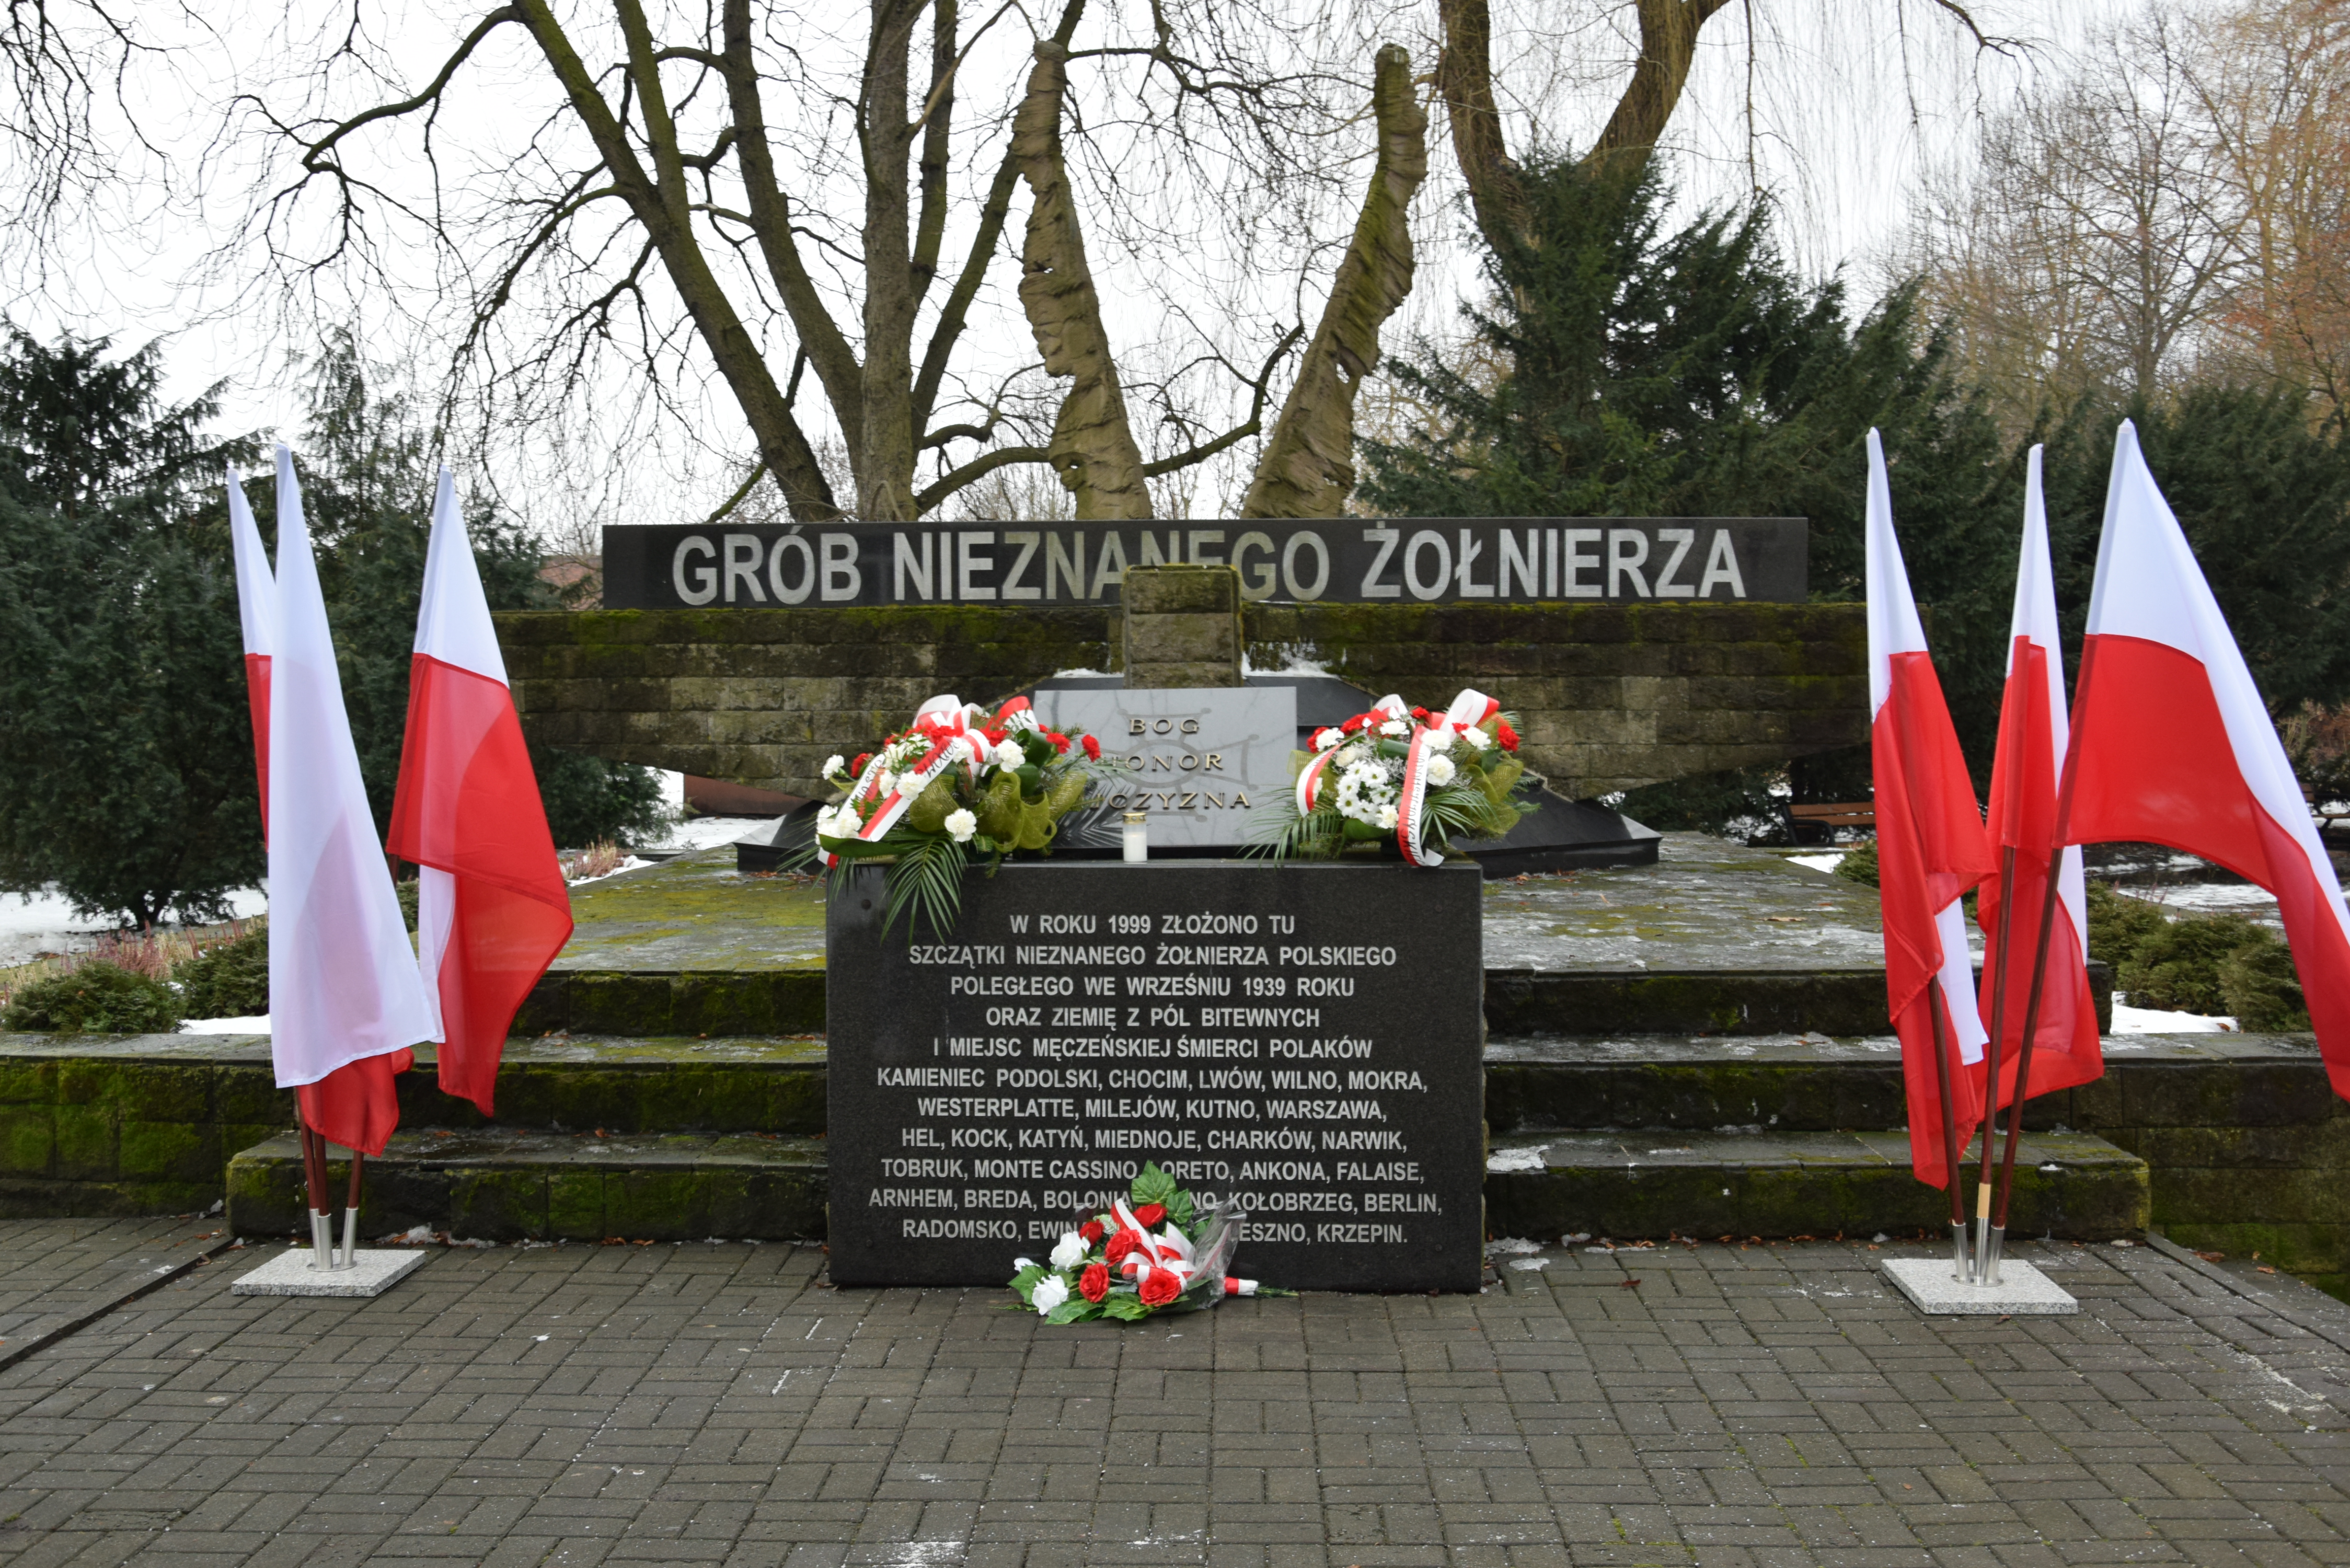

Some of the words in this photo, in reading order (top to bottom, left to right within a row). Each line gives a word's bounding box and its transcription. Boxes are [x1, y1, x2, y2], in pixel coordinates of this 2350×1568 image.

[673, 525, 861, 606] GRÓB
[1361, 521, 1746, 601] ŻOŁNIERZA
[1130, 719, 1199, 734] BOG
[1090, 791, 1251, 810] JCZYZNA
[1009, 915, 1029, 933] W
[1040, 915, 1096, 934] ROKU
[1108, 915, 1151, 934] 1999
[1161, 910, 1258, 935] ZŁOŻONO
[1269, 915, 1295, 934] TU
[909, 945, 1005, 969] SZCZĄTKI
[1016, 946, 1146, 965] NIEZNANEGO
[1156, 942, 1270, 965] ŻOŁNIERZA
[1280, 946, 1397, 966] POLSKIEGO
[951, 976, 1074, 996] POLEGŁEGO
[1084, 976, 1116, 996] WE
[1126, 974, 1230, 996] WRZEŚNIU
[1242, 977, 1286, 997] 1939
[1297, 977, 1354, 997] ROKU
[986, 1007, 1041, 1026] ORAZ
[1051, 1007, 1116, 1031] ZIEMIĘ
[1127, 1008, 1140, 1027] Z
[1150, 1004, 1191, 1027] PÓL
[1202, 1008, 1319, 1028] BITEWNYCH
[934, 1037, 938, 1056] I
[950, 1037, 1021, 1057] MIEJSC
[1033, 1034, 1171, 1062] MĘCZEŃSKIEJ
[1177, 1034, 1258, 1058] ŚMIERCI
[1270, 1035, 1373, 1058] POLAKÓW
[878, 1067, 985, 1087] KAMIENIEC
[997, 1068, 1102, 1091] PODOLSKI,
[1109, 1069, 1193, 1091] CHOCIM,
[1199, 1066, 1265, 1092] LWÓW,
[1271, 1070, 1342, 1093] WILNO,
[1349, 1070, 1427, 1093] MOKRA,
[917, 1098, 1079, 1121] WESTERPLATTE,
[1086, 1096, 1180, 1122] MILEJÓW,
[1186, 1099, 1260, 1122] KUTNO,
[1266, 1100, 1387, 1123] WARSZAWA,
[902, 1128, 945, 1150] HEL,
[951, 1128, 1012, 1151] KOCK,
[1019, 1125, 1089, 1151] KATYŃ,
[1095, 1129, 1201, 1152] MIEDNOJE,
[1207, 1126, 1316, 1153] CHARKÓW,
[1322, 1131, 1407, 1153] NARWIK,
[881, 1158, 968, 1181] TOBRUK,
[974, 1159, 1043, 1178] MONTE
[1049, 1160, 1139, 1179] CASSINO
[1160, 1161, 1234, 1183] ORETO,
[1239, 1161, 1330, 1184] ANKONA,
[1337, 1162, 1424, 1184] FALAISE,
[869, 1189, 958, 1211] ARNHEM,
[964, 1189, 1037, 1212] BREDA,
[1229, 1192, 1358, 1214] KOŁOBRZEG,
[1365, 1193, 1442, 1215] BERLIN,
[903, 1219, 1021, 1242] RADOMSKO,
[1028, 1221, 1083, 1241] EWIN
[1237, 1223, 1310, 1244] ESZNO,
[1317, 1224, 1407, 1243] KRZEPIN.
